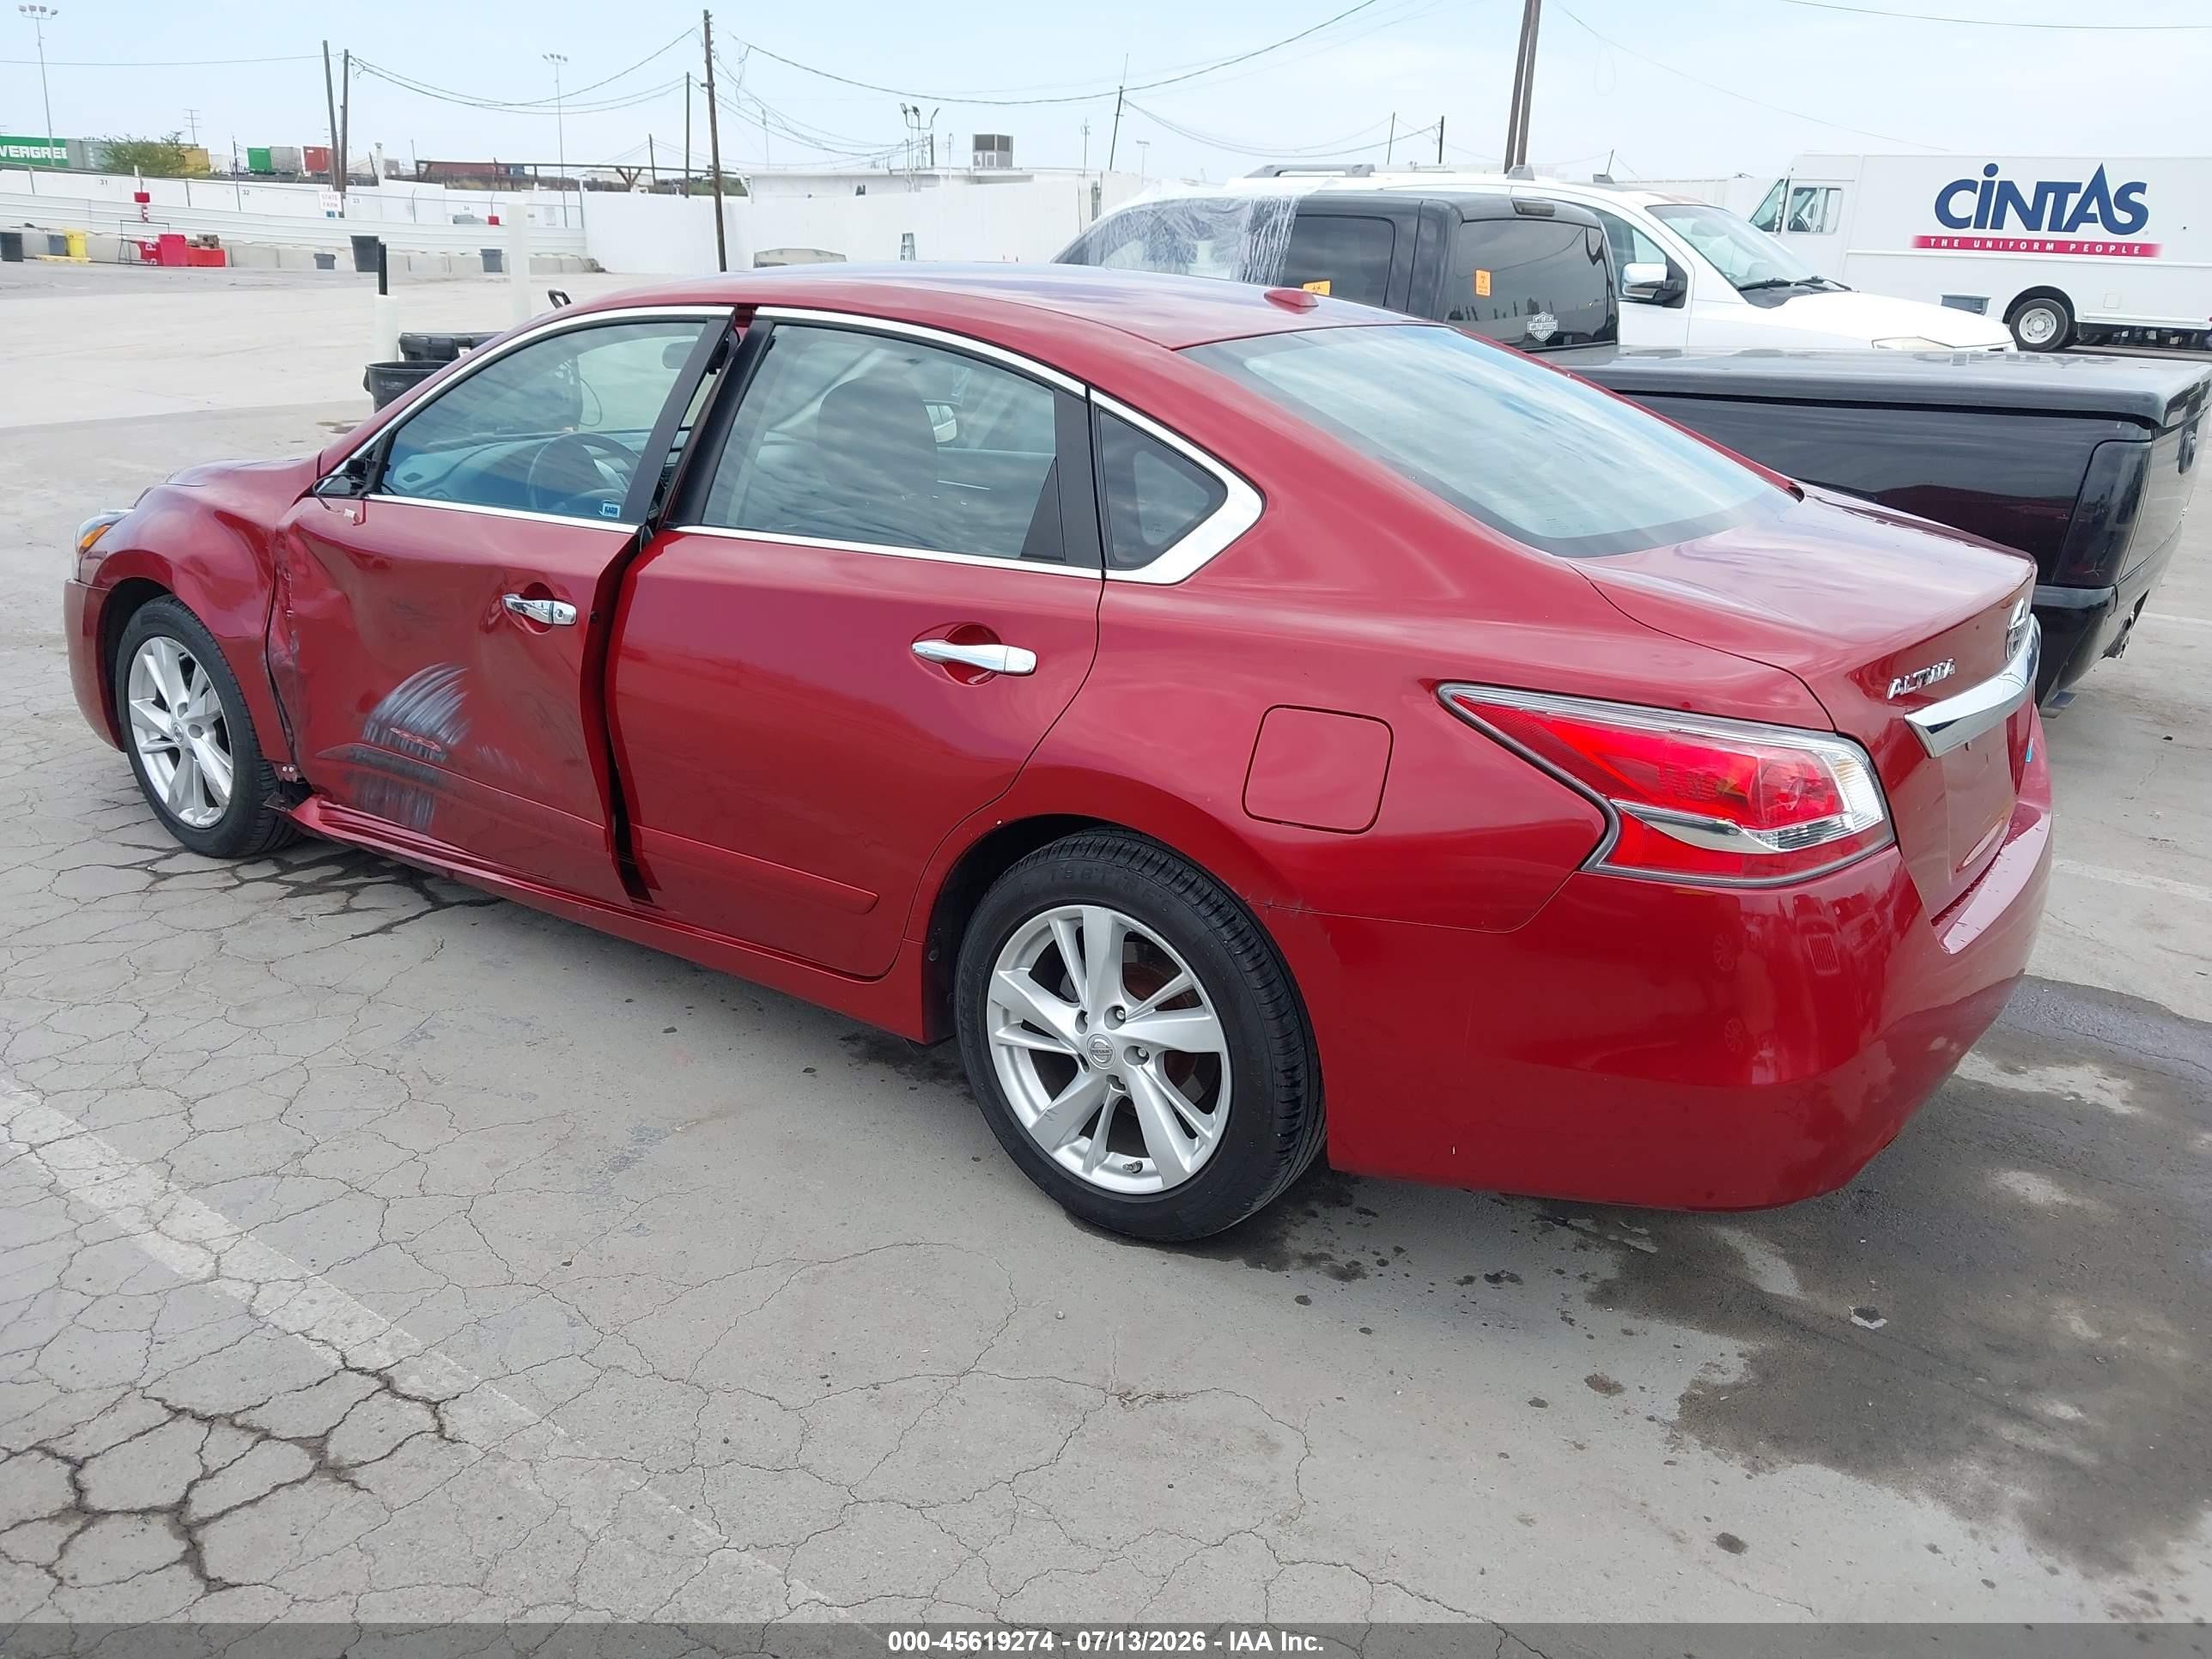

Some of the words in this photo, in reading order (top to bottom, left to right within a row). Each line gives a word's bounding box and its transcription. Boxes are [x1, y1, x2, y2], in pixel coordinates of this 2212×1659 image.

[1930, 238, 1960, 247] THE
[1973, 240, 2055, 251] UNIFORM
[2069, 242, 2141, 254] PEOPLE
